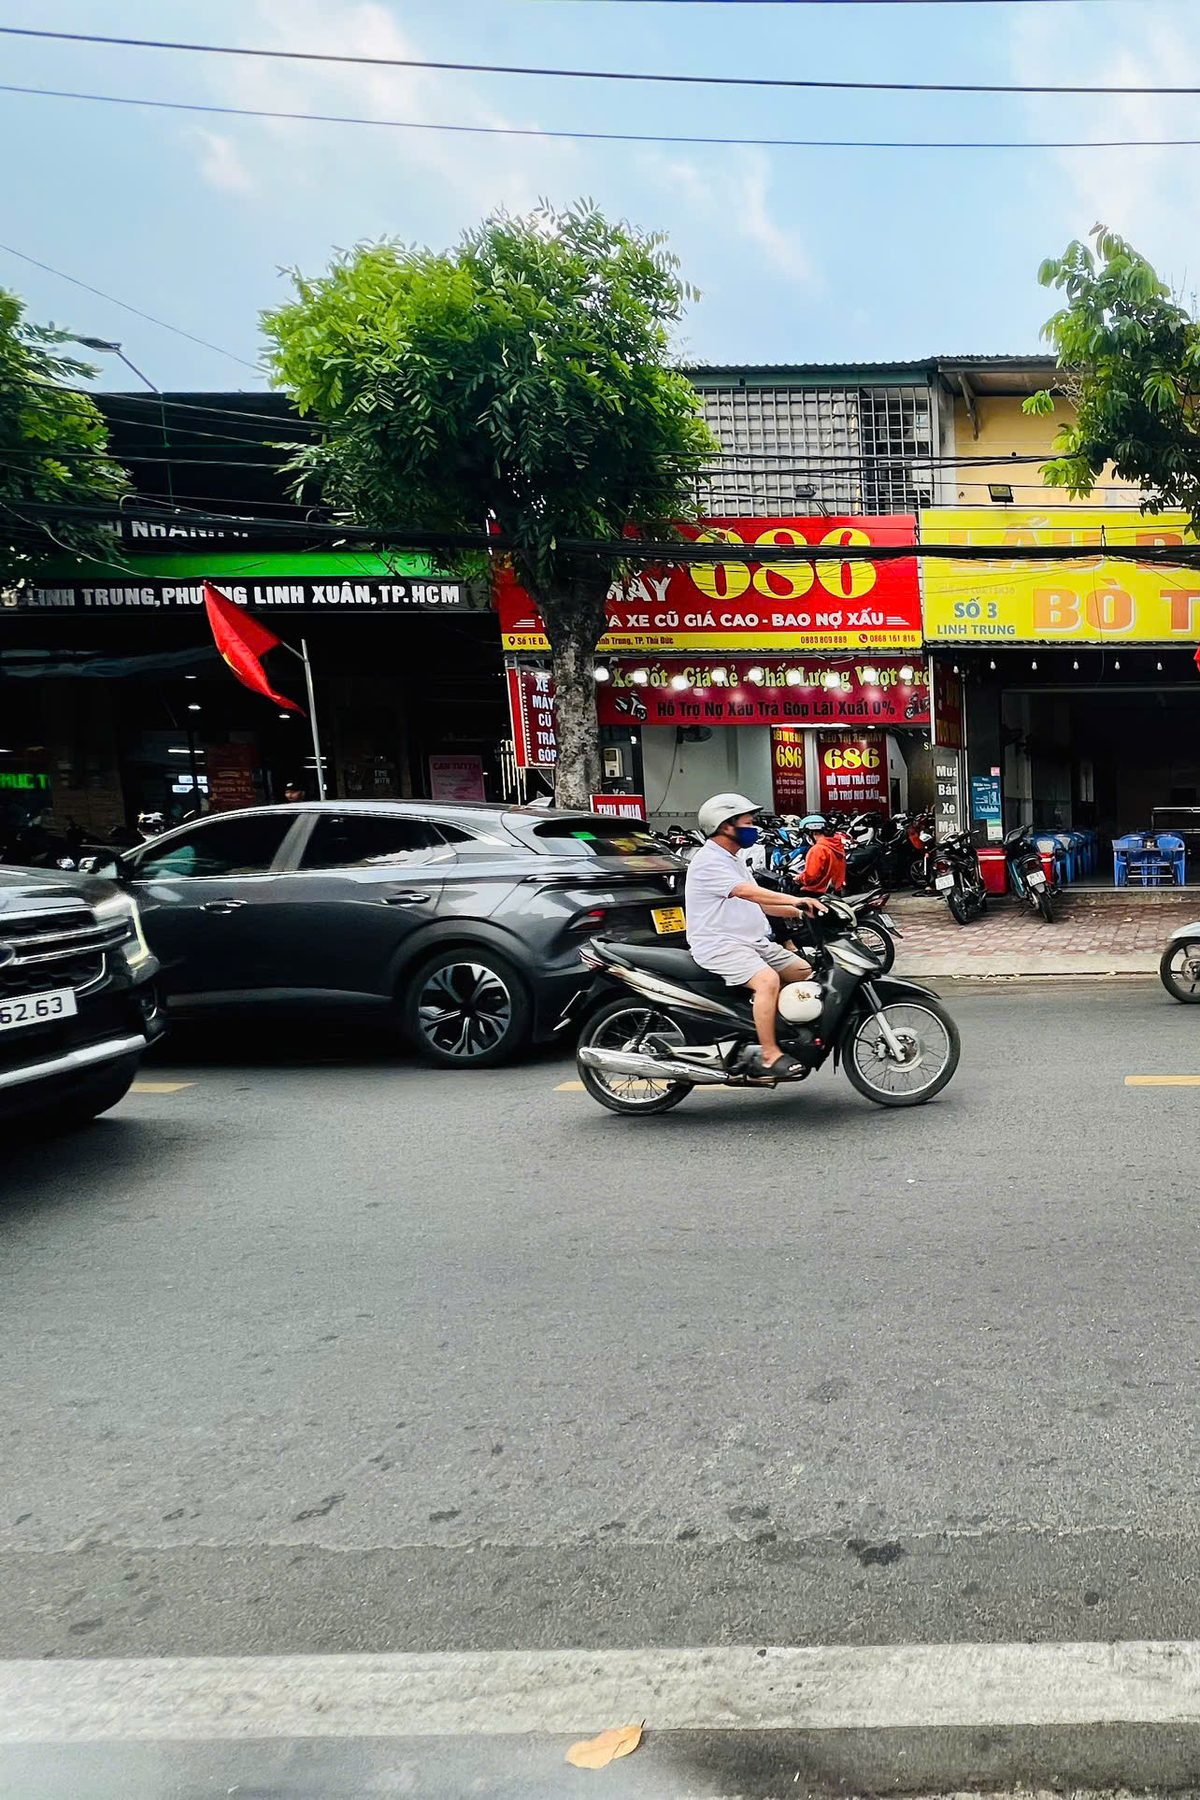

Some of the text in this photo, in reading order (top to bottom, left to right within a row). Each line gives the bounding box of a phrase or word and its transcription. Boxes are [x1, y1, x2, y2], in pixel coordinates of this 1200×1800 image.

[690, 528, 877, 600] 686
[254, 586, 304, 604] LINH
[954, 597, 998, 618] SỐ 3
[1033, 578, 1135, 632] BÒ
[626, 614, 650, 627] XE
[654, 610, 679, 627] CŨ
[684, 610, 716, 627] GIÁ
[719, 613, 758, 627] CAO
[772, 612, 811, 627] BAO
[816, 610, 842, 629] NỢ
[847, 607, 884, 626] XẤU
[937, 624, 1016, 635] LINH TRUNG
[536, 678, 549, 692] XE
[612, 668, 634, 687] Xe
[532, 694, 554, 710] MÁY
[538, 711, 552, 727] CŨ
[536, 729, 556, 745] TRẢ
[538, 747, 557, 761] GÓP
[776, 744, 803, 769] 686
[824, 747, 880, 769] 686
[936, 765, 958, 778] Mua
[938, 784, 958, 796] Bán
[942, 803, 955, 815] Xe
